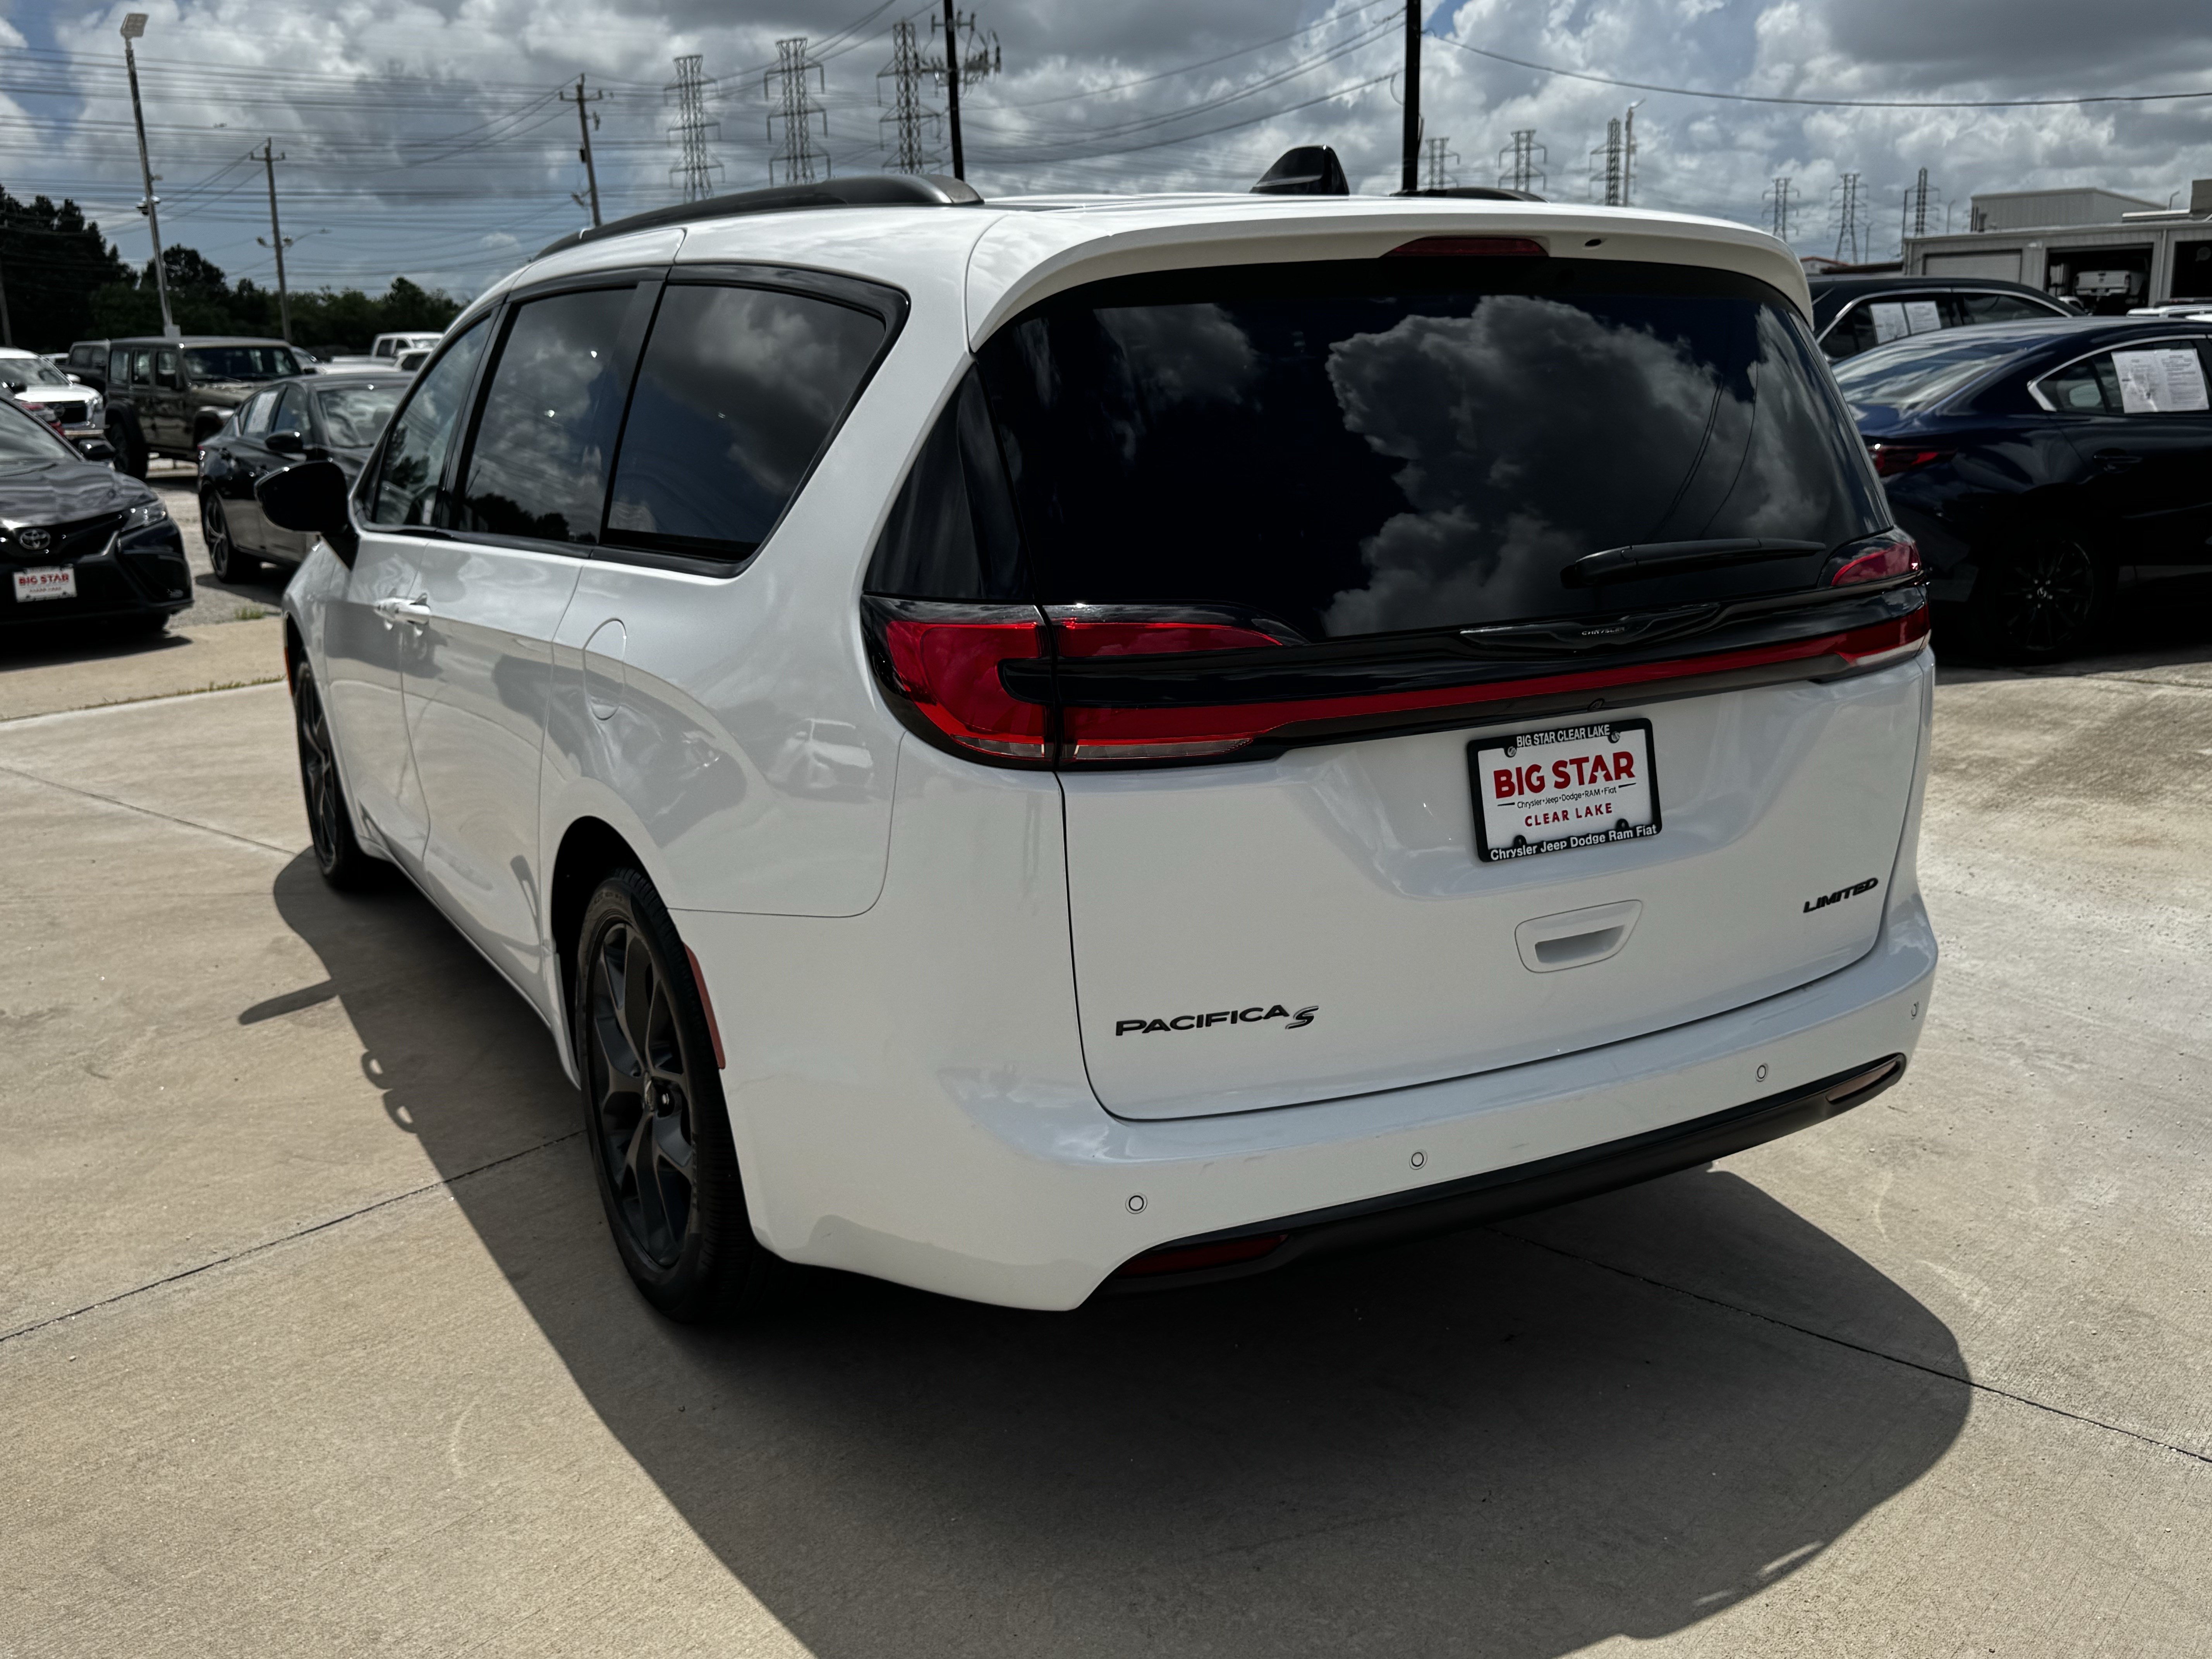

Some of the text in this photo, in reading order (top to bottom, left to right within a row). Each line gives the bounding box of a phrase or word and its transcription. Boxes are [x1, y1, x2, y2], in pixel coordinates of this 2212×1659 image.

[1516, 725, 1610, 747] BIG STAR CLEAR LAKE
[1493, 751, 1635, 799] BIG STAR
[1525, 803, 1612, 827] CLEAR LAKE
[1491, 824, 1657, 861] Chrysler Jeep Dodge Ram Fiat
[1803, 878, 1879, 913] LIMITED
[1116, 1005, 1319, 1036] PACIFICA S
